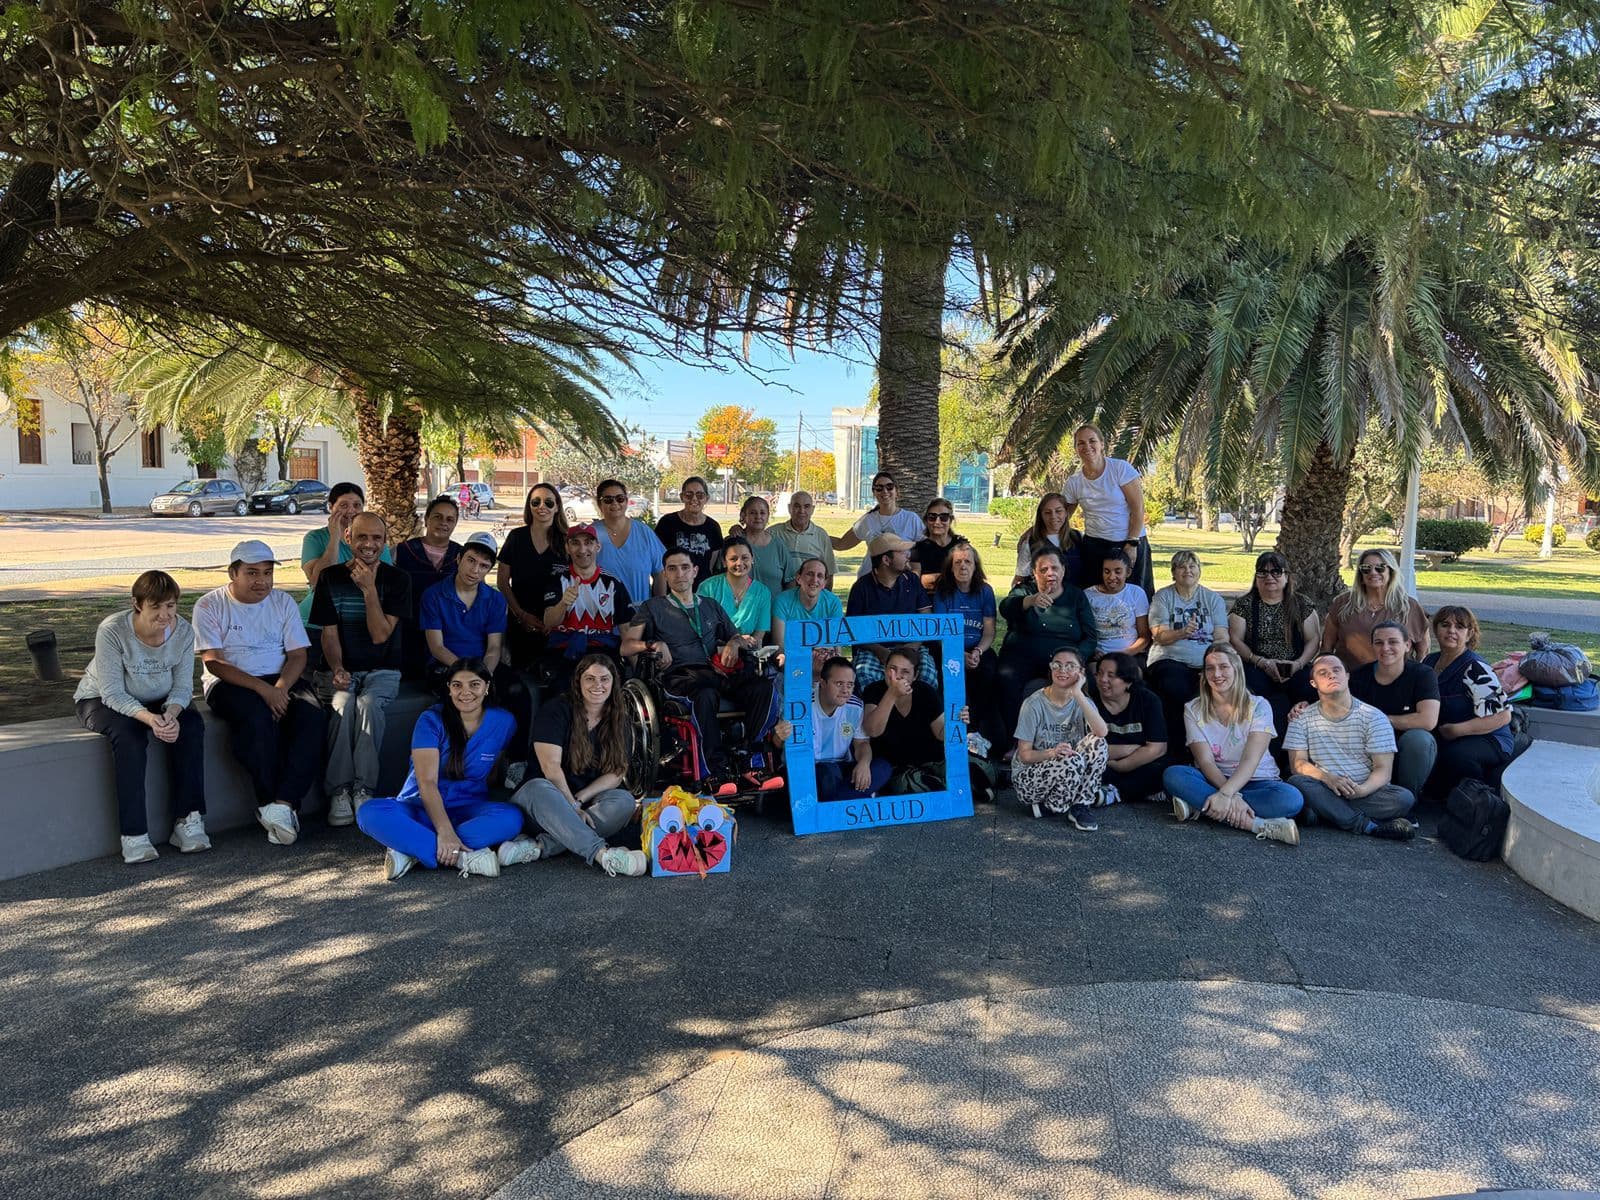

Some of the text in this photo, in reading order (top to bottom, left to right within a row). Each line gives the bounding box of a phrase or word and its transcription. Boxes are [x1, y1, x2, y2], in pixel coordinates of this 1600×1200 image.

[801, 617, 962, 647] DIA MUNDIAL
[845, 799, 925, 826] SALUD
